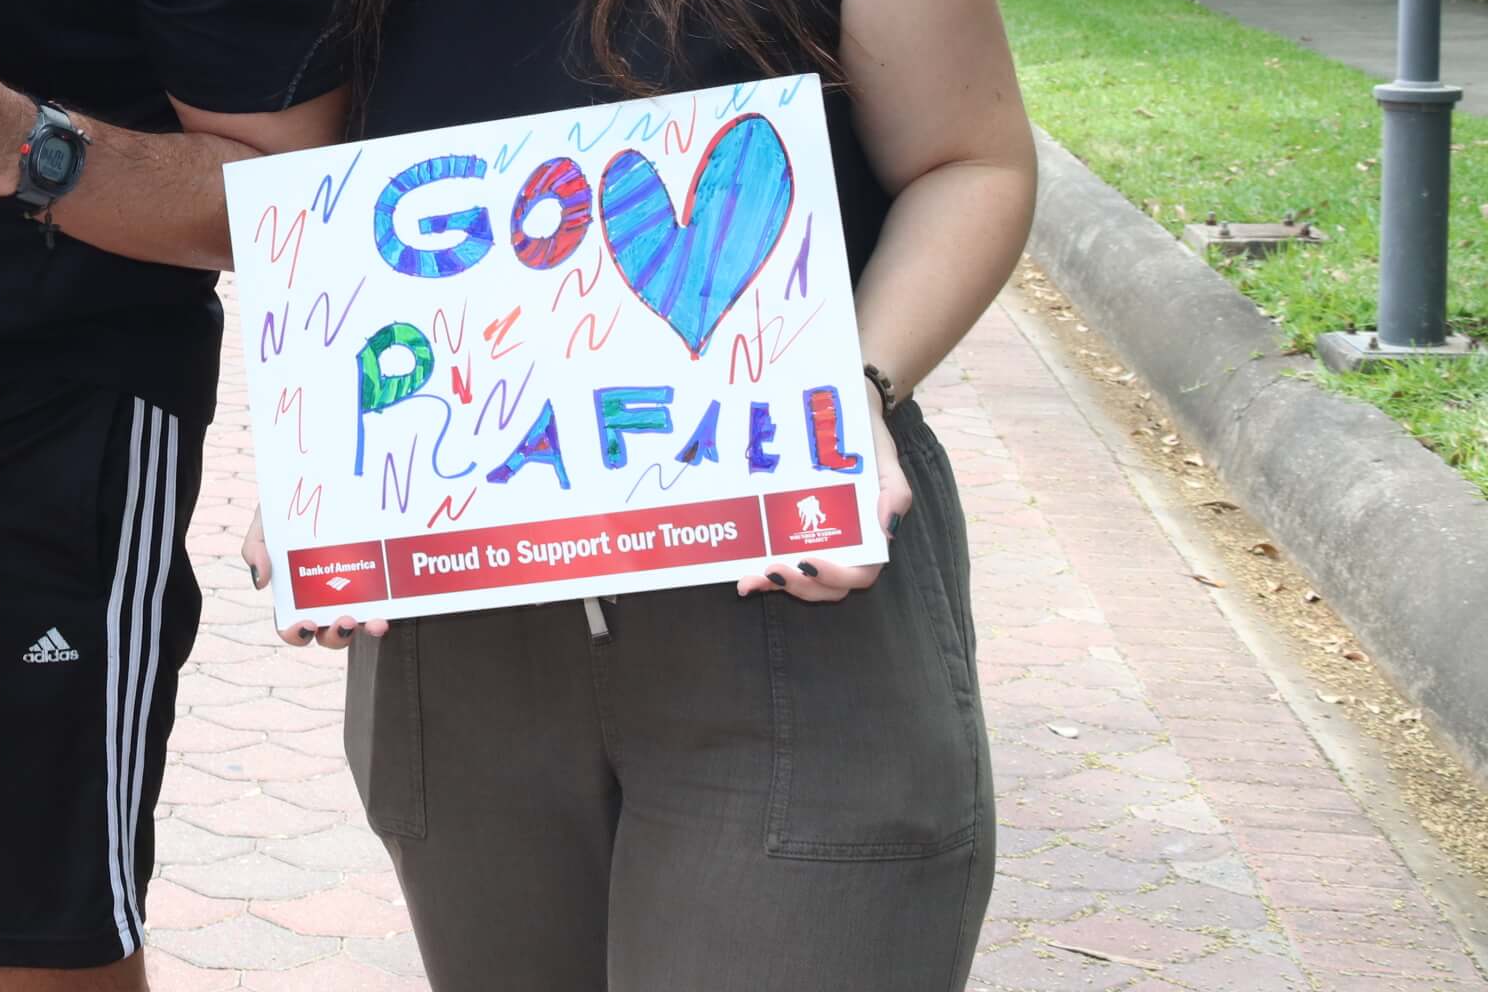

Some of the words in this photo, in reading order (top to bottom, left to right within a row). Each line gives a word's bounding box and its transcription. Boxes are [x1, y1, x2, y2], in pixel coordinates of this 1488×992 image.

[411, 546, 480, 576] Proud
[486, 545, 511, 568] to
[516, 532, 612, 566] Support
[617, 530, 657, 554] our
[658, 521, 738, 549] Troops
[298, 565, 324, 578] Bank
[324, 563, 334, 574] of
[335, 560, 376, 573] America
[22, 649, 80, 663] adidas
